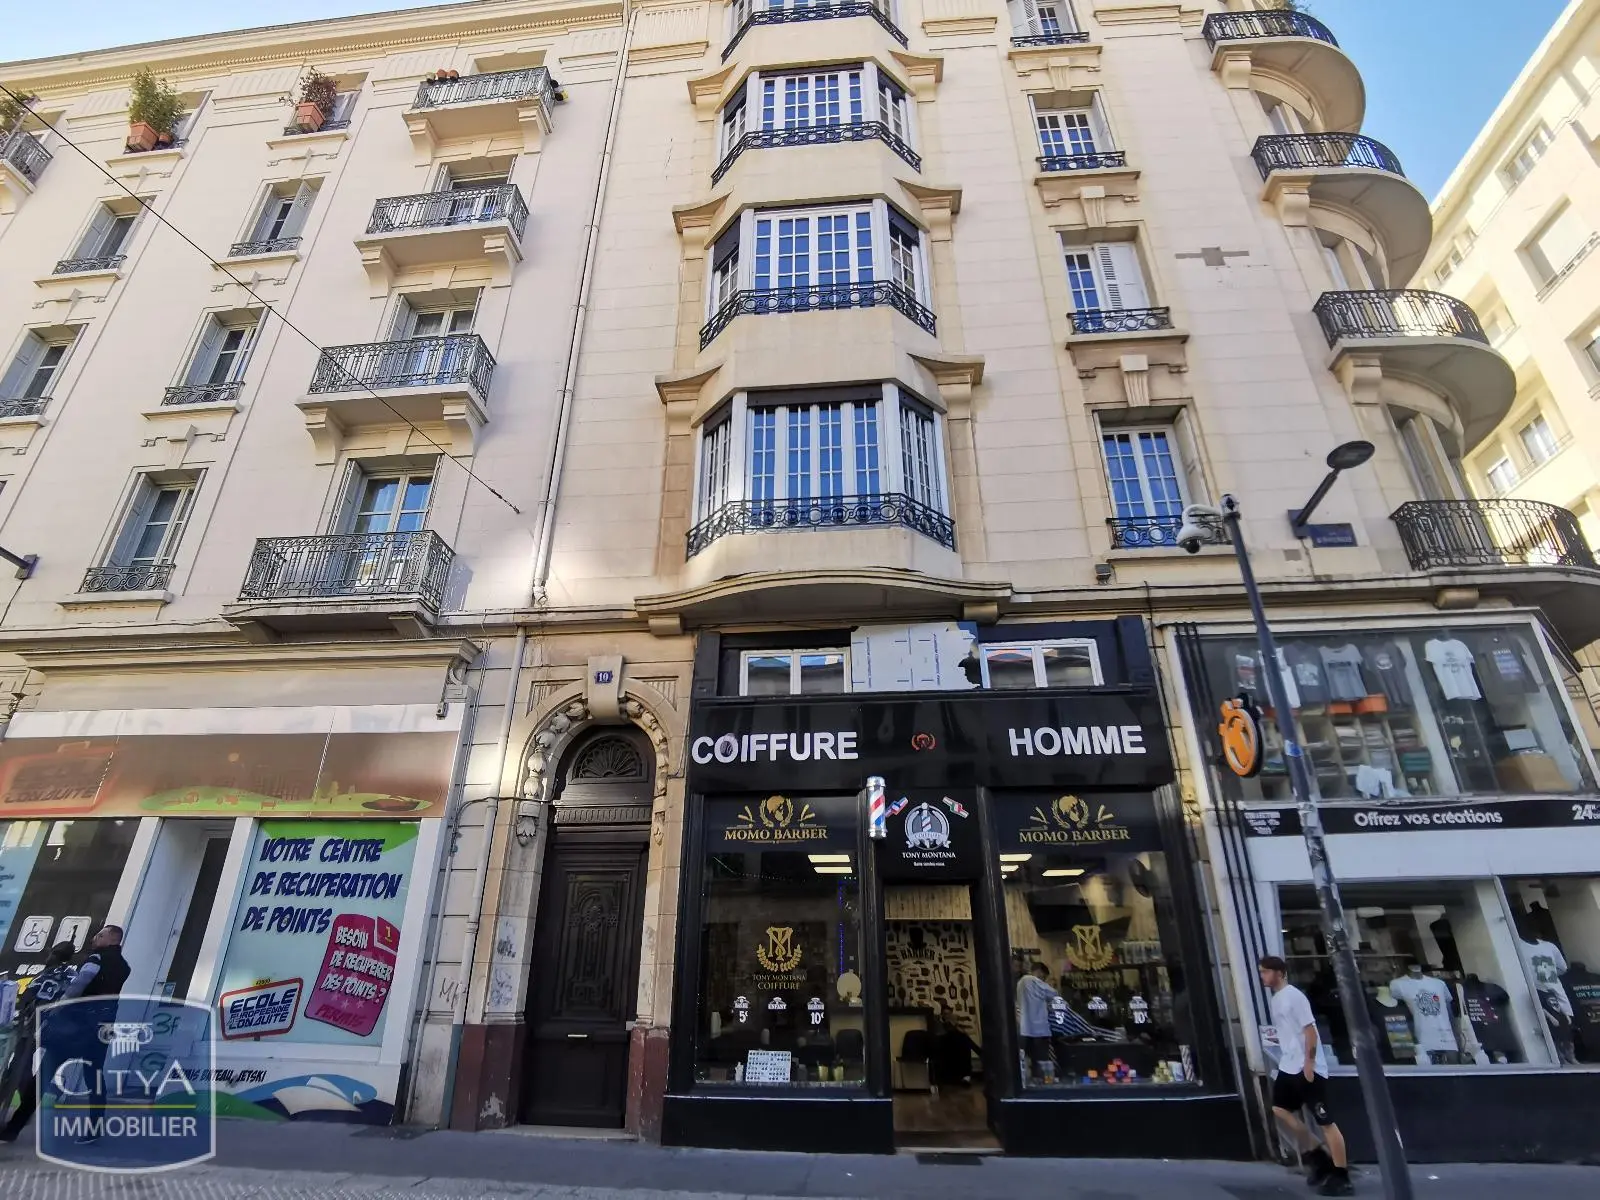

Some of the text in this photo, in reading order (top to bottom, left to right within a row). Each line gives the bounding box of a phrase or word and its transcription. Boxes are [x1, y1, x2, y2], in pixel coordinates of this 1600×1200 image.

[691, 731, 859, 765] COIFFURE
[1008, 725, 1147, 756] HOMME
[1353, 809, 1503, 827] Offrez vos créations
[724, 828, 828, 840] MOMO BARBER
[1019, 829, 1131, 842] MOMO BARBER
[259, 838, 385, 864] VOTRE CENTRE
[902, 851, 956, 859] TONY MONTANA
[250, 871, 403, 900] DE RECUPERATION
[240, 906, 333, 934] DE POINTS
[335, 926, 369, 949] BESOIN
[329, 950, 394, 982] DE RECUPERER
[320, 973, 343, 990] DES
[230, 988, 298, 1014] ECOLE
[237, 1069, 267, 1083] JETSKI
